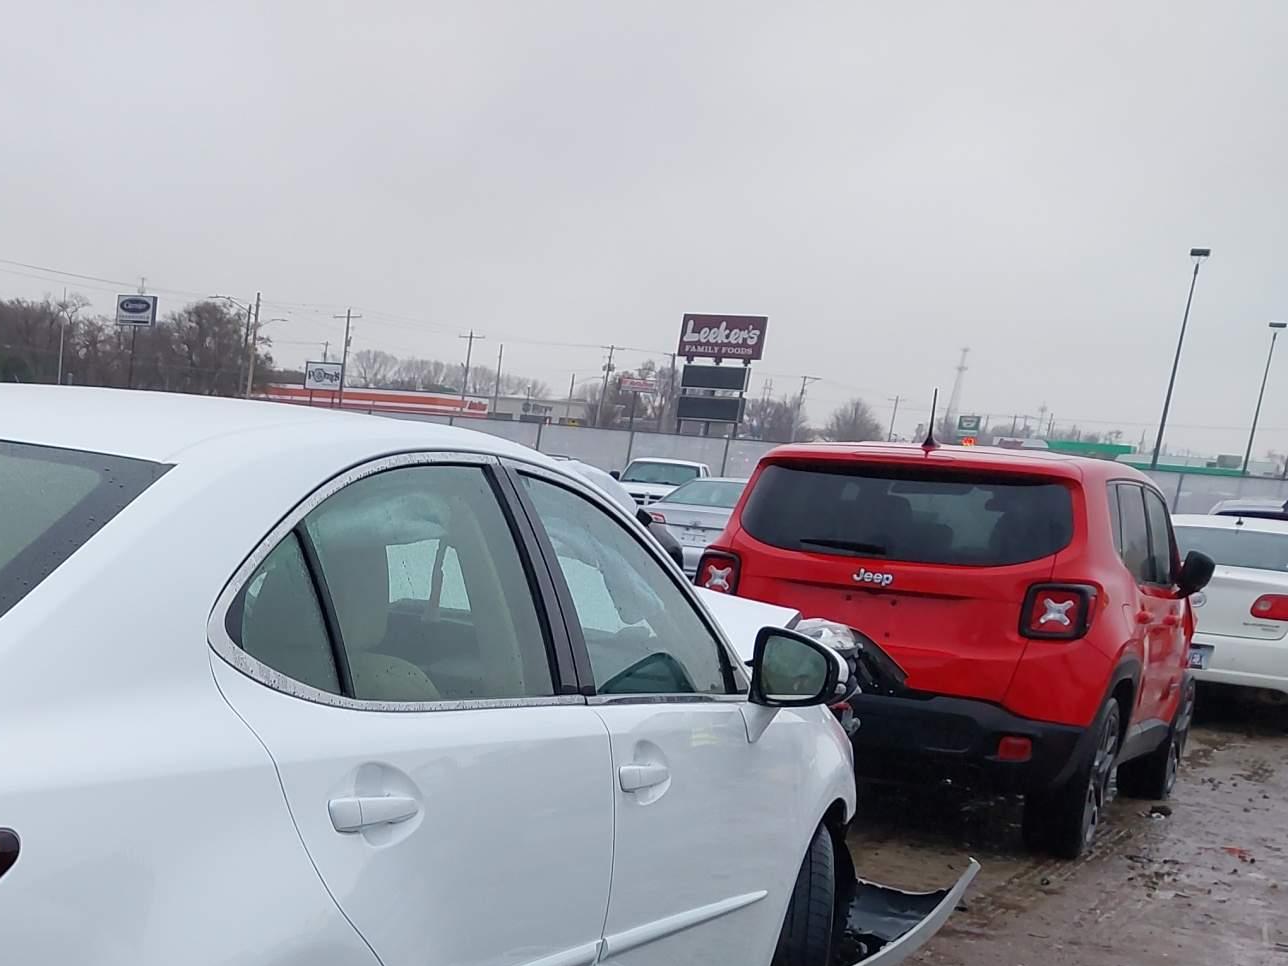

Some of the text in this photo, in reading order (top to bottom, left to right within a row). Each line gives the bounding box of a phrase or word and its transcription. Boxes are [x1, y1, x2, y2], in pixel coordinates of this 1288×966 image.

[683, 319, 761, 345] Leeker's
[685, 345, 753, 355] FAMILY FOODS
[852, 567, 893, 587] Jeep
